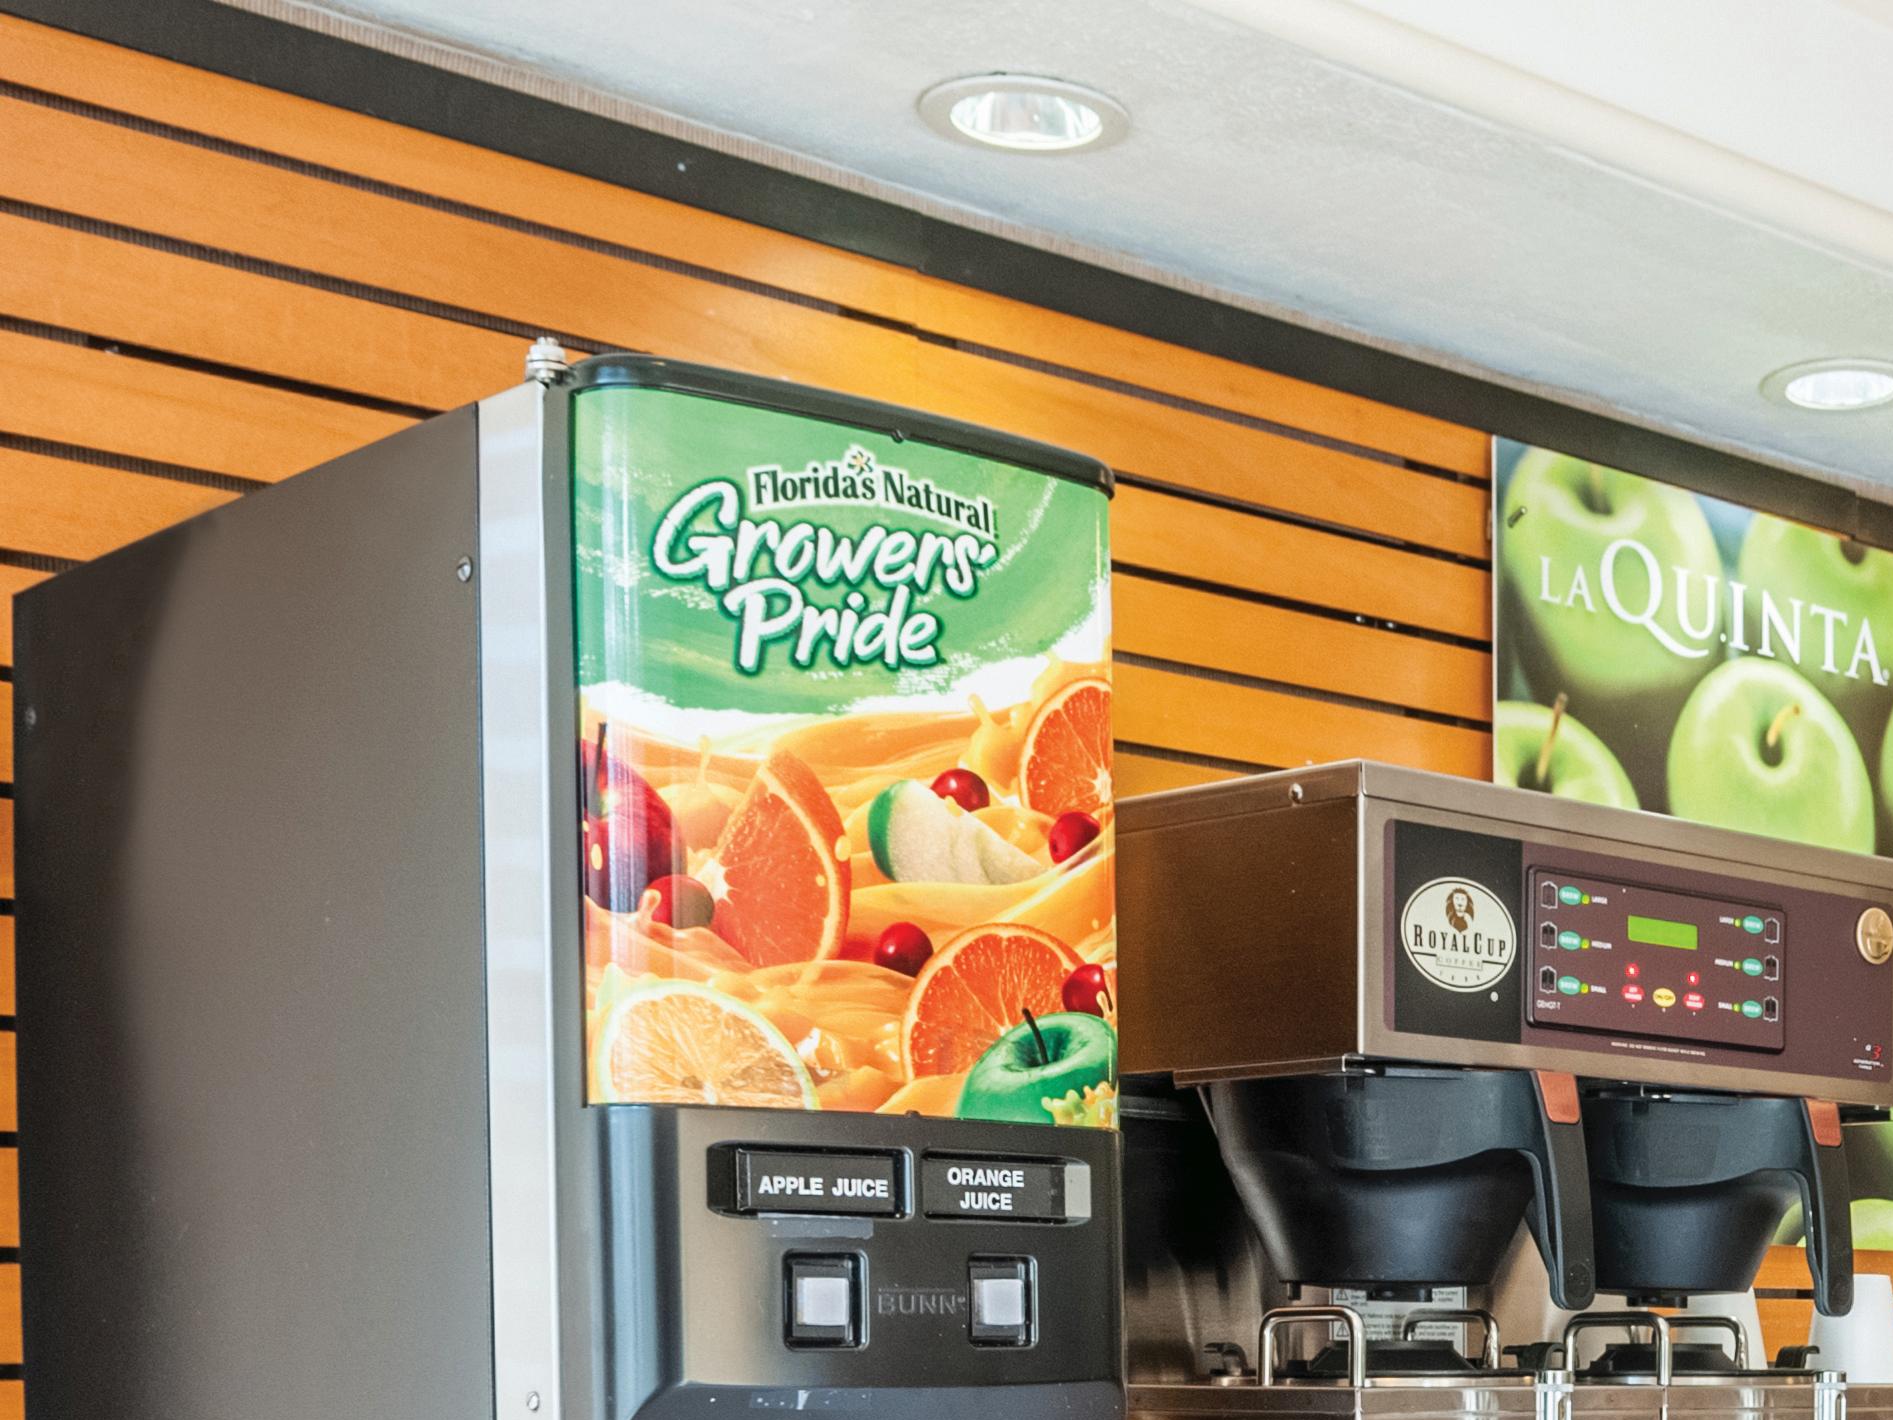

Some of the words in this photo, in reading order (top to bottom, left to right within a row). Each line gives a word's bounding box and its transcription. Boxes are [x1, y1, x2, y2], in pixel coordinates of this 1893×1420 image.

[883, 470, 992, 534] Natural
[724, 578, 939, 672] Pride
[1539, 555, 1598, 613] LA
[1600, 538, 1888, 686] QUINTA
[758, 1175, 824, 1196] APPLE
[831, 1178, 889, 1198] JUICE
[947, 1167, 1024, 1188] ORANGE
[959, 1192, 1013, 1211] JUICE
